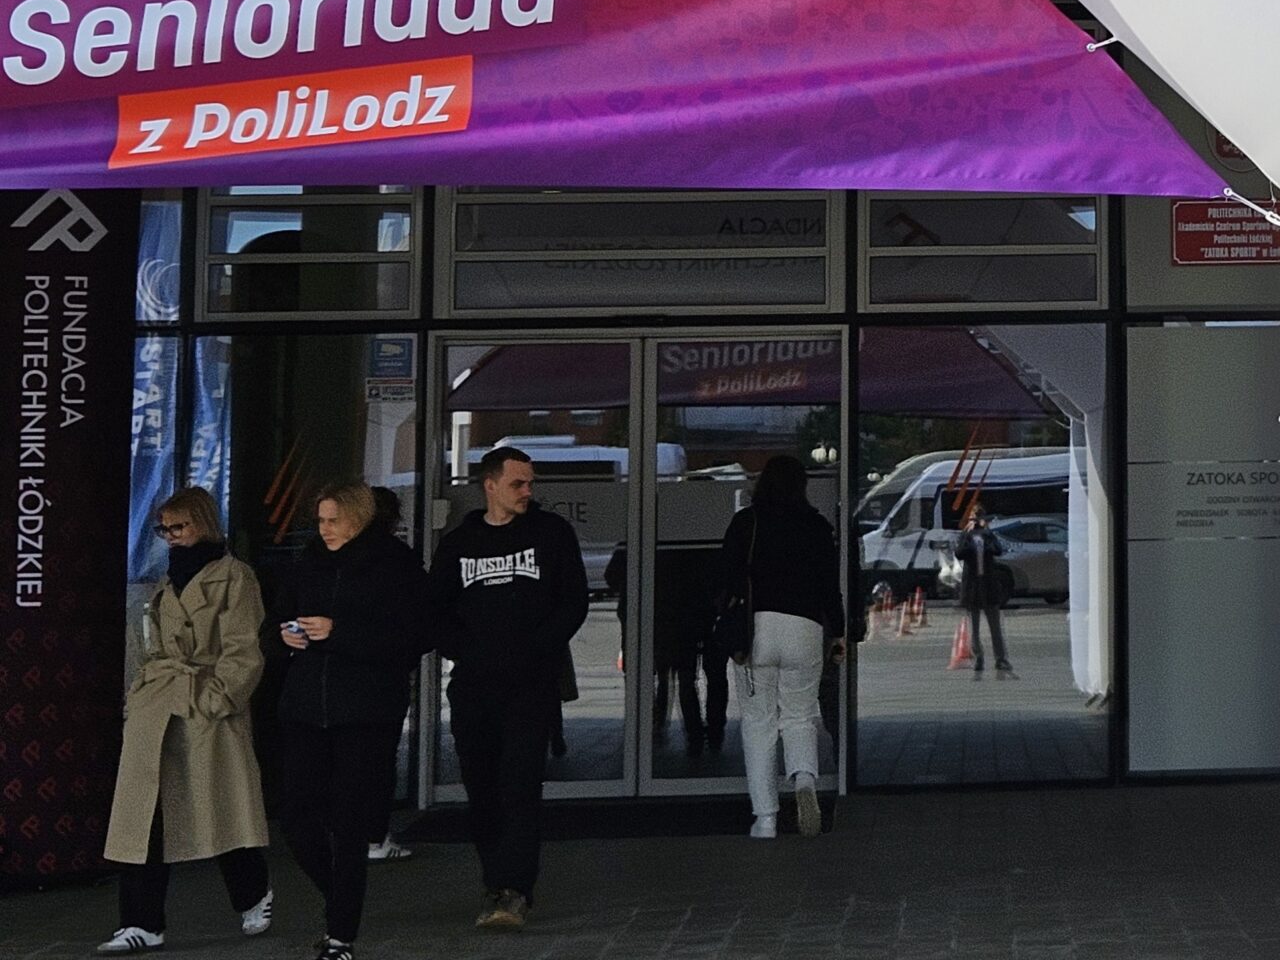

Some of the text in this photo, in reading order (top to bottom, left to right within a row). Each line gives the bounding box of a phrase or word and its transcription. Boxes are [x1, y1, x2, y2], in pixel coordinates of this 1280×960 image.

[128, 75, 457, 155] z PoliLodz
[60, 275, 88, 428] FUNDACJA
[16, 275, 52, 607] POLITECHNIKI ŁÓDZKIEJ
[1186, 472, 1246, 486] ZATOKA
[459, 548, 540, 588] LONSDALE
[483, 576, 514, 586] LONDON
